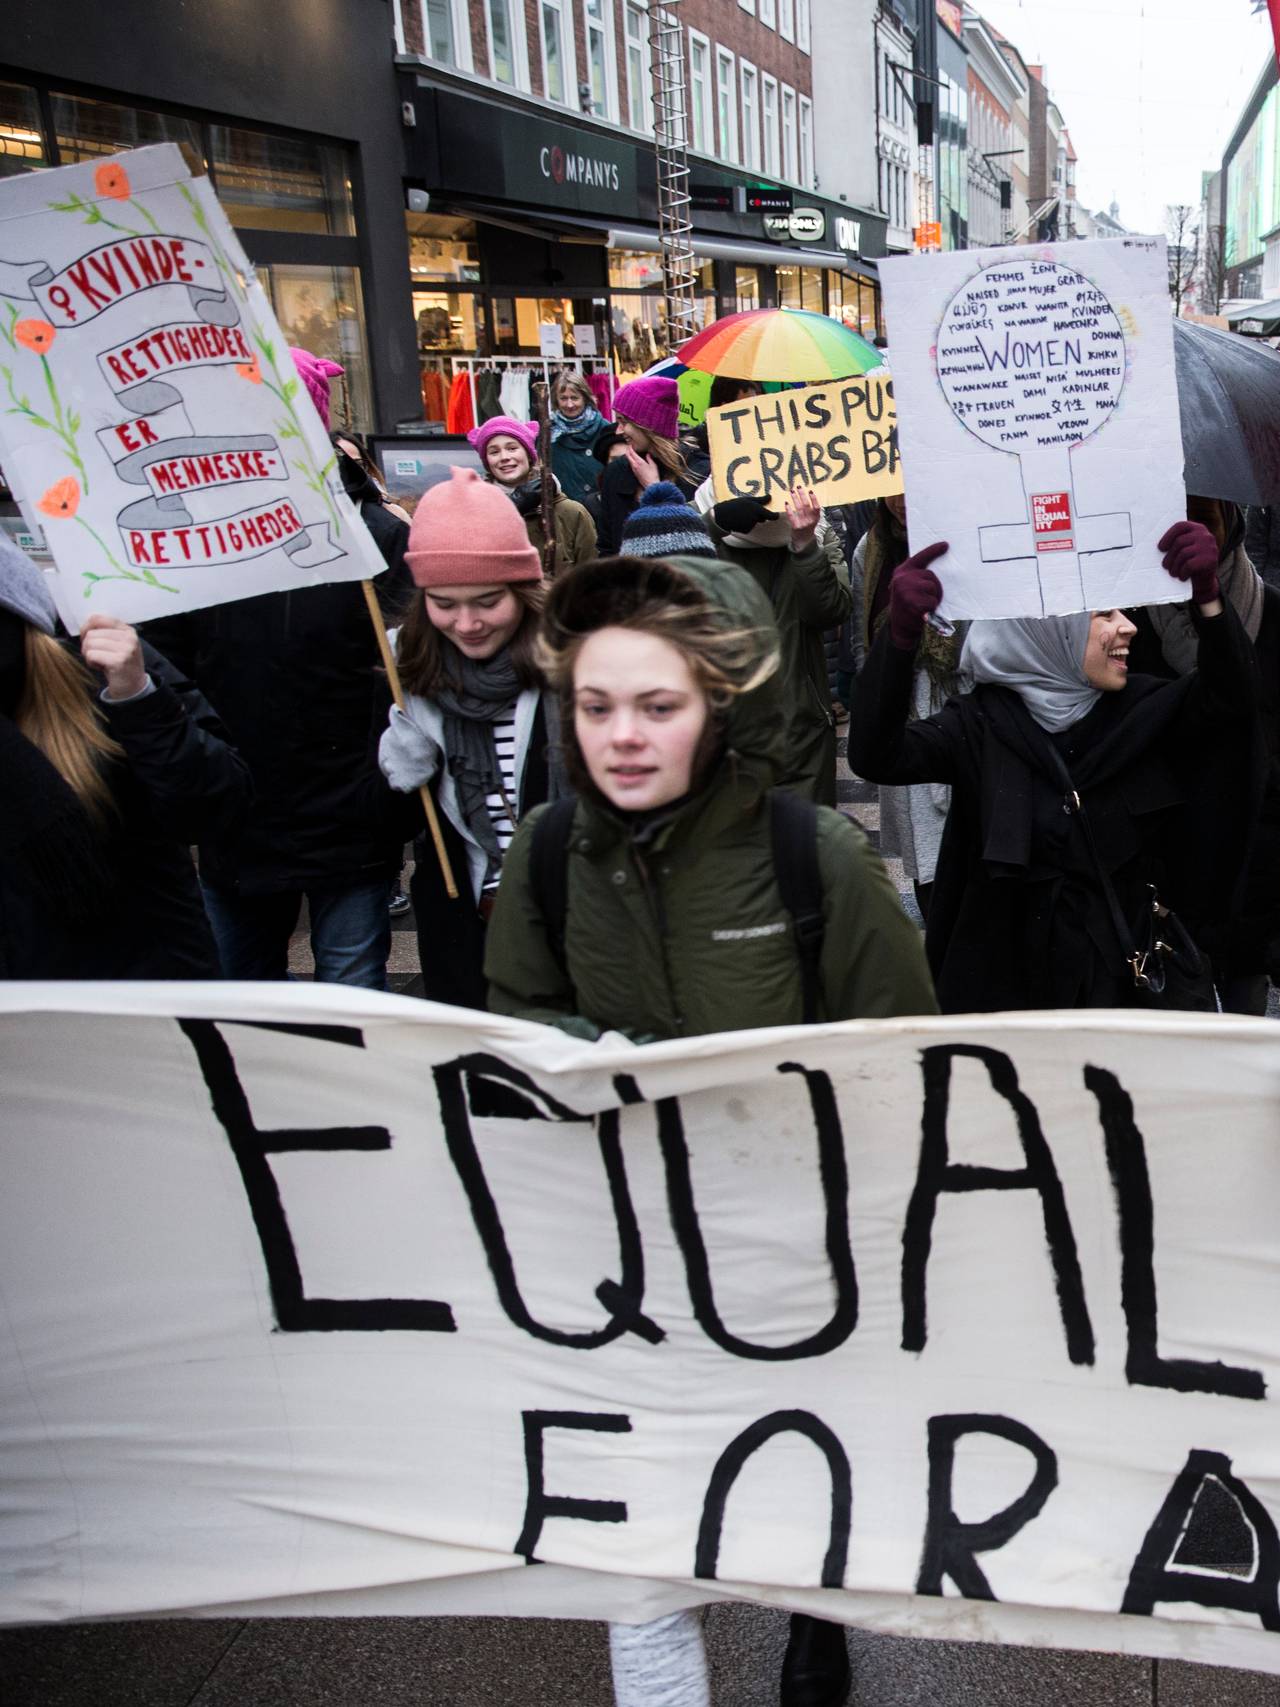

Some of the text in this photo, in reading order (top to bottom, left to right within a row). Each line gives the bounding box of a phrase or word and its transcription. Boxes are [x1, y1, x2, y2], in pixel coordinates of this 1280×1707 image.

[540, 145, 619, 191] COMPANYS
[749, 198, 790, 208] COMPANYS
[789, 216, 821, 231] ONLY
[836, 216, 860, 251] ONLY
[69, 239, 206, 311] KVINDE-
[986, 272, 1024, 282] FEMMES
[967, 289, 999, 302] NAISED
[1029, 285, 1056, 296] MUJER
[1092, 331, 1122, 341] DONNA
[107, 323, 252, 385] RETTIGHEDER
[975, 331, 1081, 371] WOMEN
[1014, 371, 1041, 380] NAISET
[1076, 367, 1120, 377] MULHERES
[953, 380, 1008, 392] WANAWAKE
[1023, 388, 1046, 398] DAMI
[976, 399, 1015, 412] FRAUEN
[720, 393, 831, 444] THIS
[115, 419, 159, 454] ER
[151, 451, 277, 494] MENNESKE-
[726, 434, 851, 499] GRABS
[1033, 495, 1061, 506] FIGHT
[1034, 505, 1046, 514] IN
[1035, 511, 1070, 522] EQUAL
[1036, 520, 1053, 530] ITY
[130, 503, 303, 564] RETTIGHEDER
